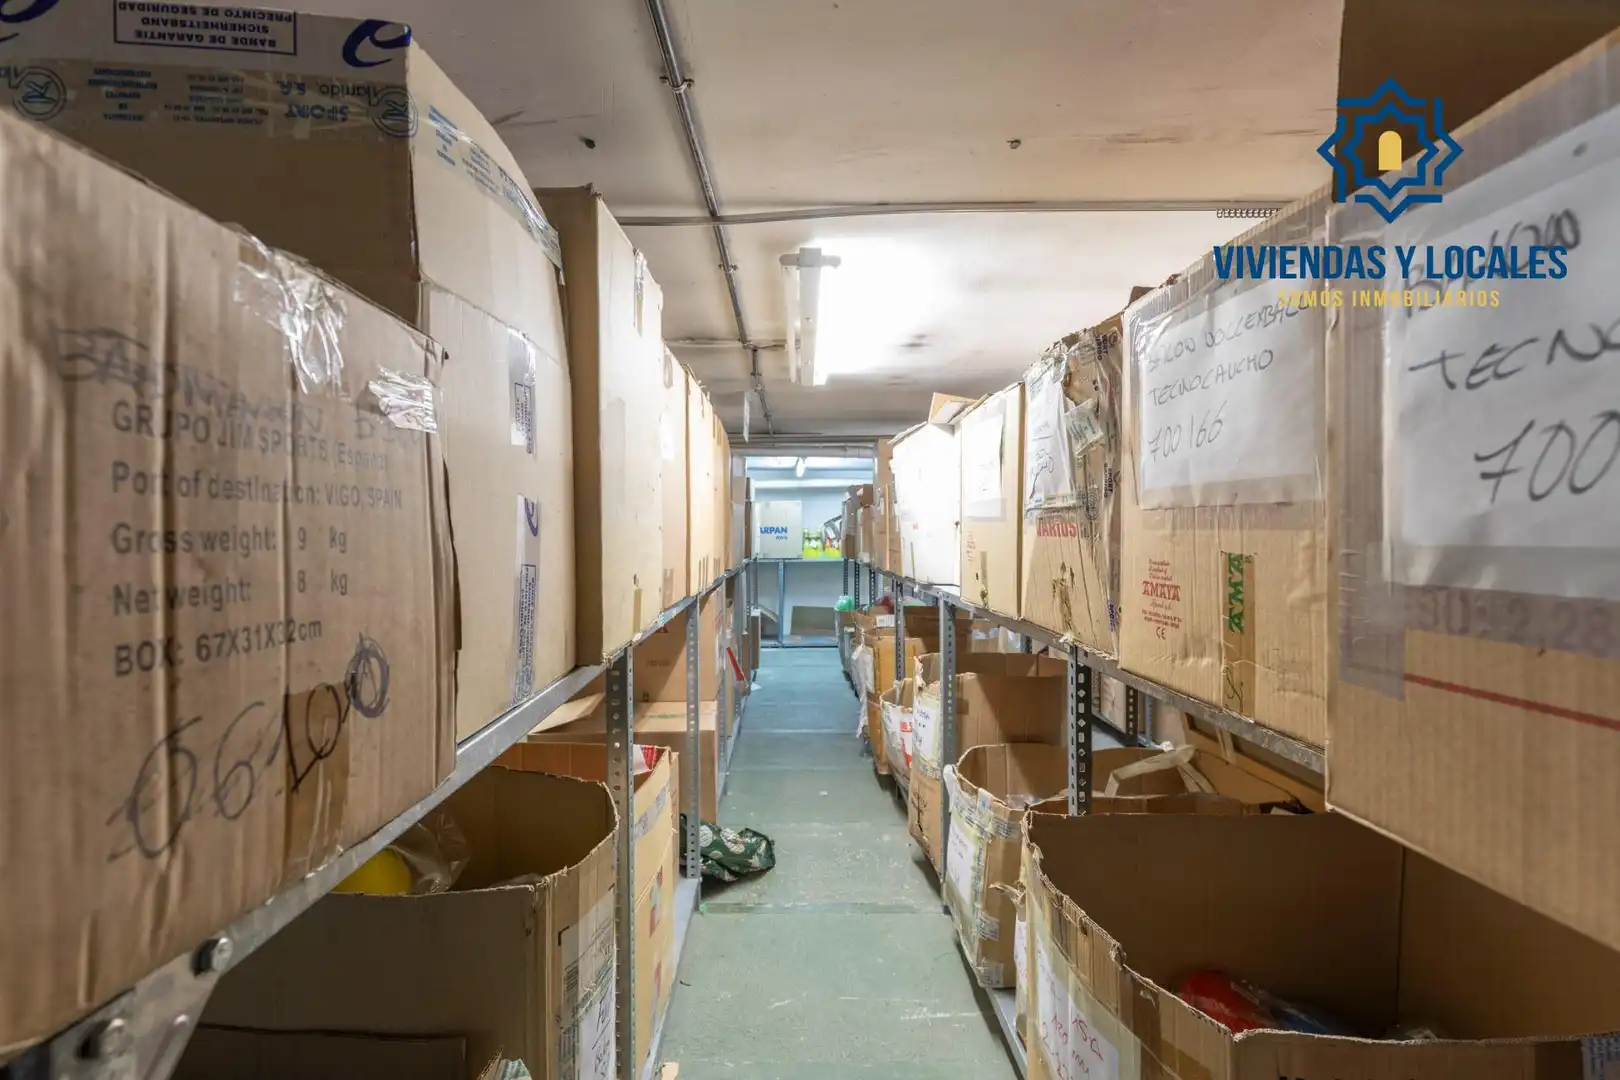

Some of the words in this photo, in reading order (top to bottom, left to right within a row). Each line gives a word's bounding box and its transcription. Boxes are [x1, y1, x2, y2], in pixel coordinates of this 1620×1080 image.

[202, 8, 219, 17] DE
[209, 35, 226, 45] DE
[179, 468, 206, 498] of
[367, 486, 403, 511] SPAIN
[111, 521, 194, 555] Gross
[202, 524, 277, 558] weight:
[296, 526, 308, 551] 9
[329, 525, 348, 554] kg
[165, 577, 252, 612] weight:
[296, 570, 307, 594] 8
[330, 569, 349, 597] kg
[1142, 580, 1181, 602] AMAYA
